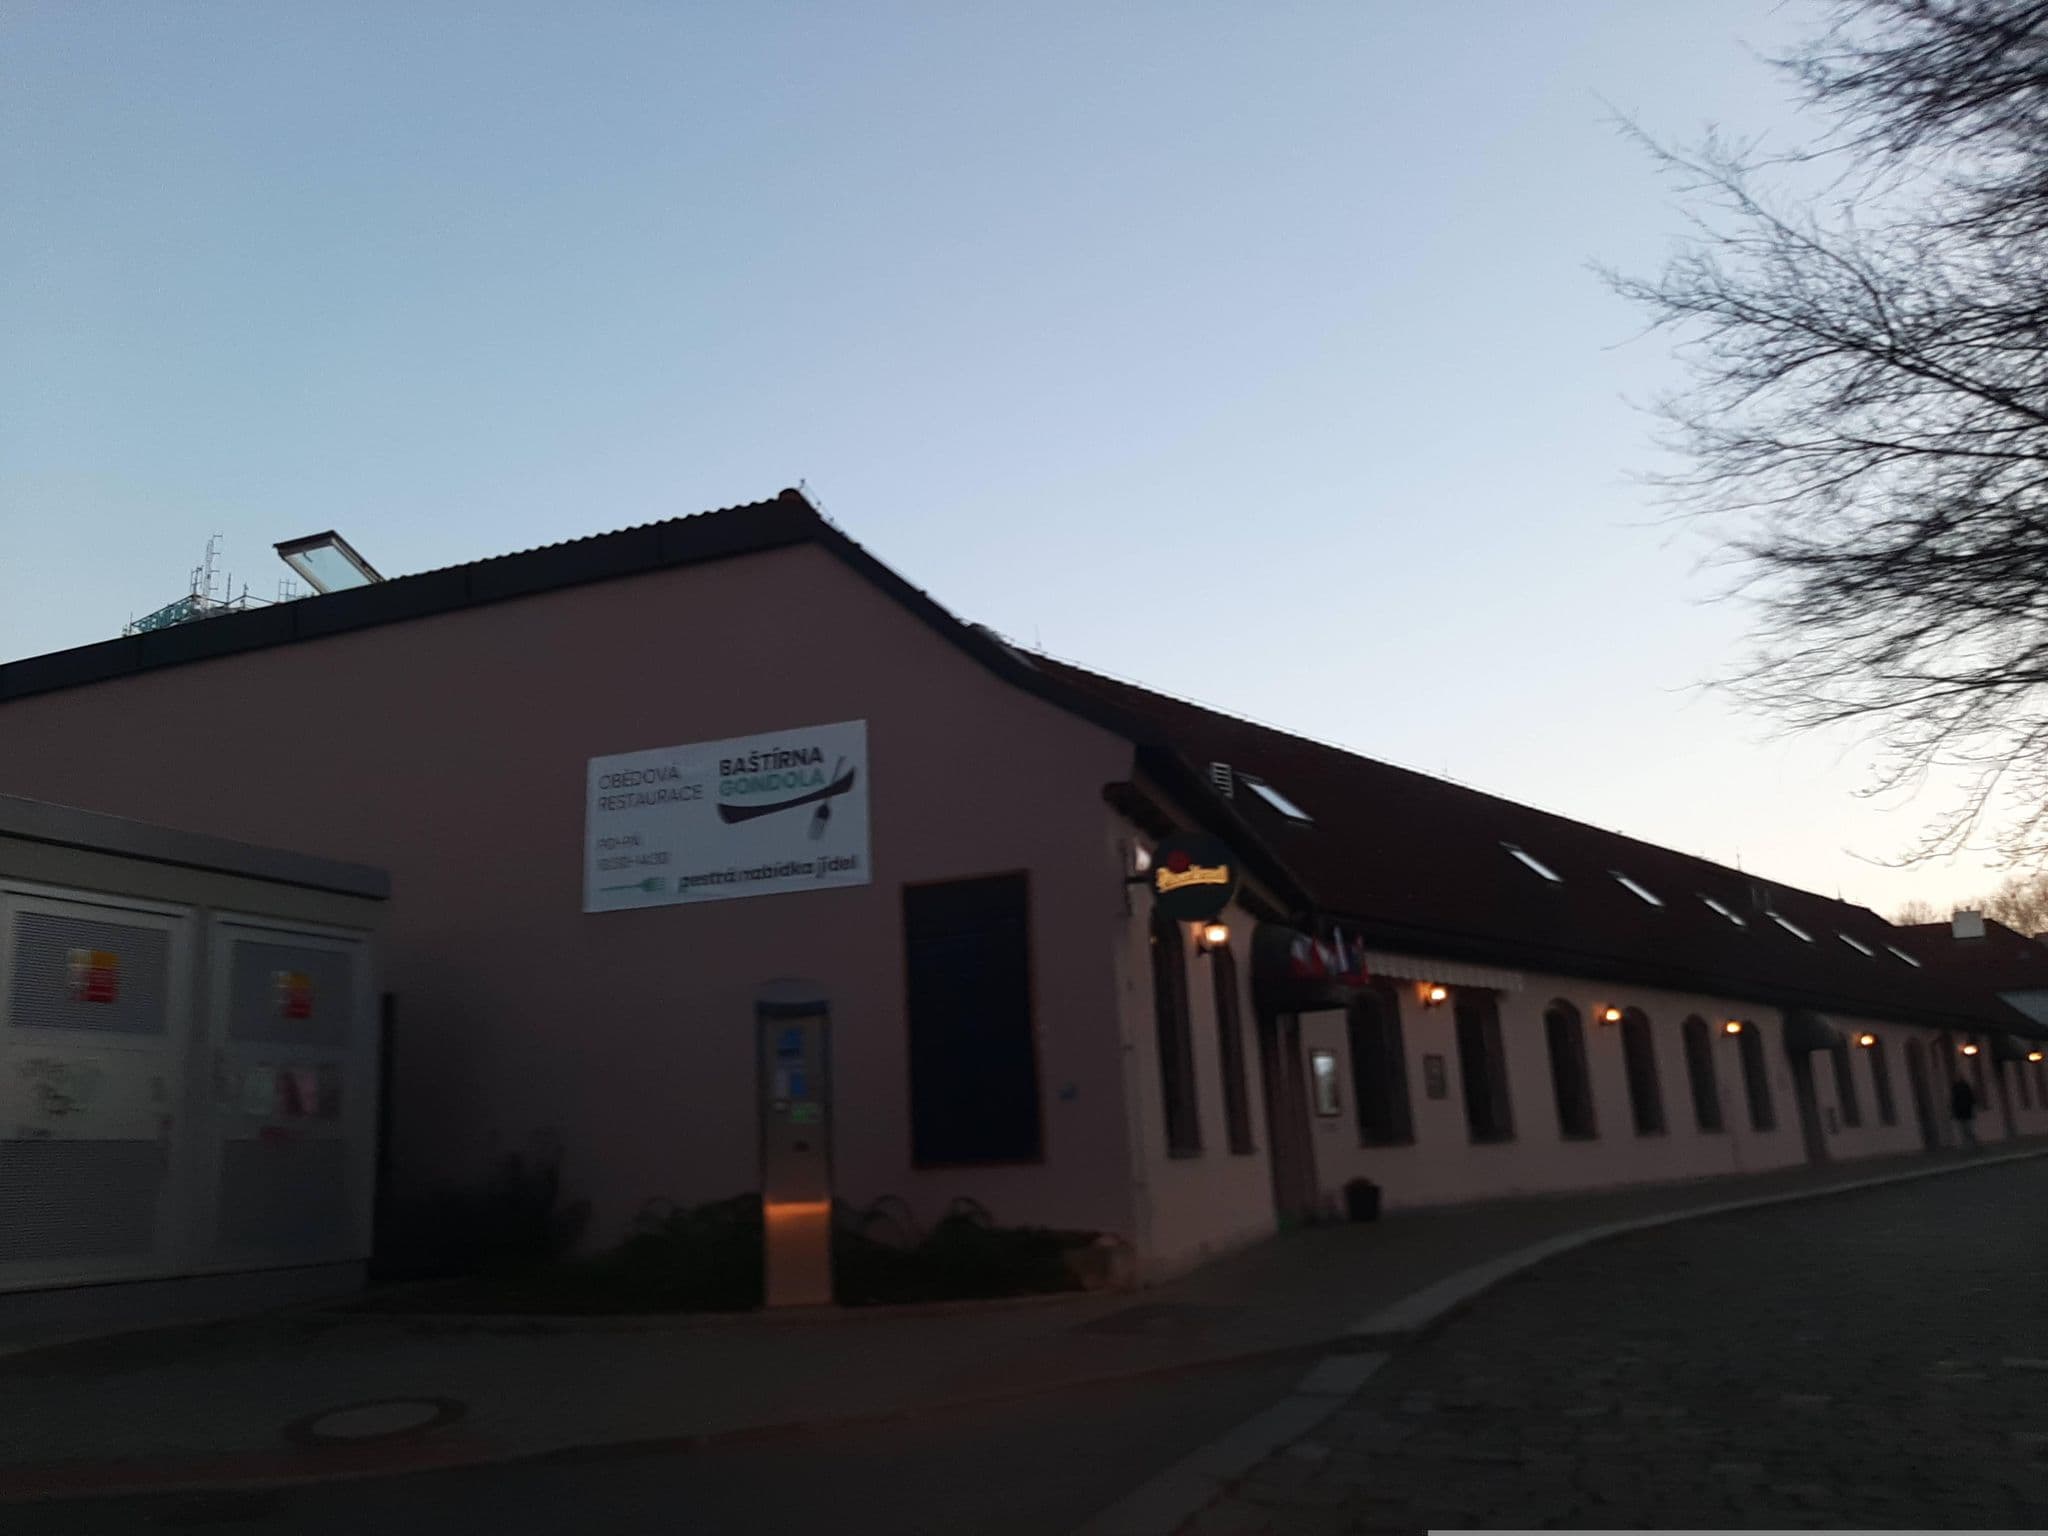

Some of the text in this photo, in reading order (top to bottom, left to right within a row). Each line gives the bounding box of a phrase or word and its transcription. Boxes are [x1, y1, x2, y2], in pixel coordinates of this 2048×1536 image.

[719, 747, 823, 776] BAŠTÍRNA
[719, 768, 825, 797] GONDOLA
[598, 784, 703, 811] RESTAURACE
